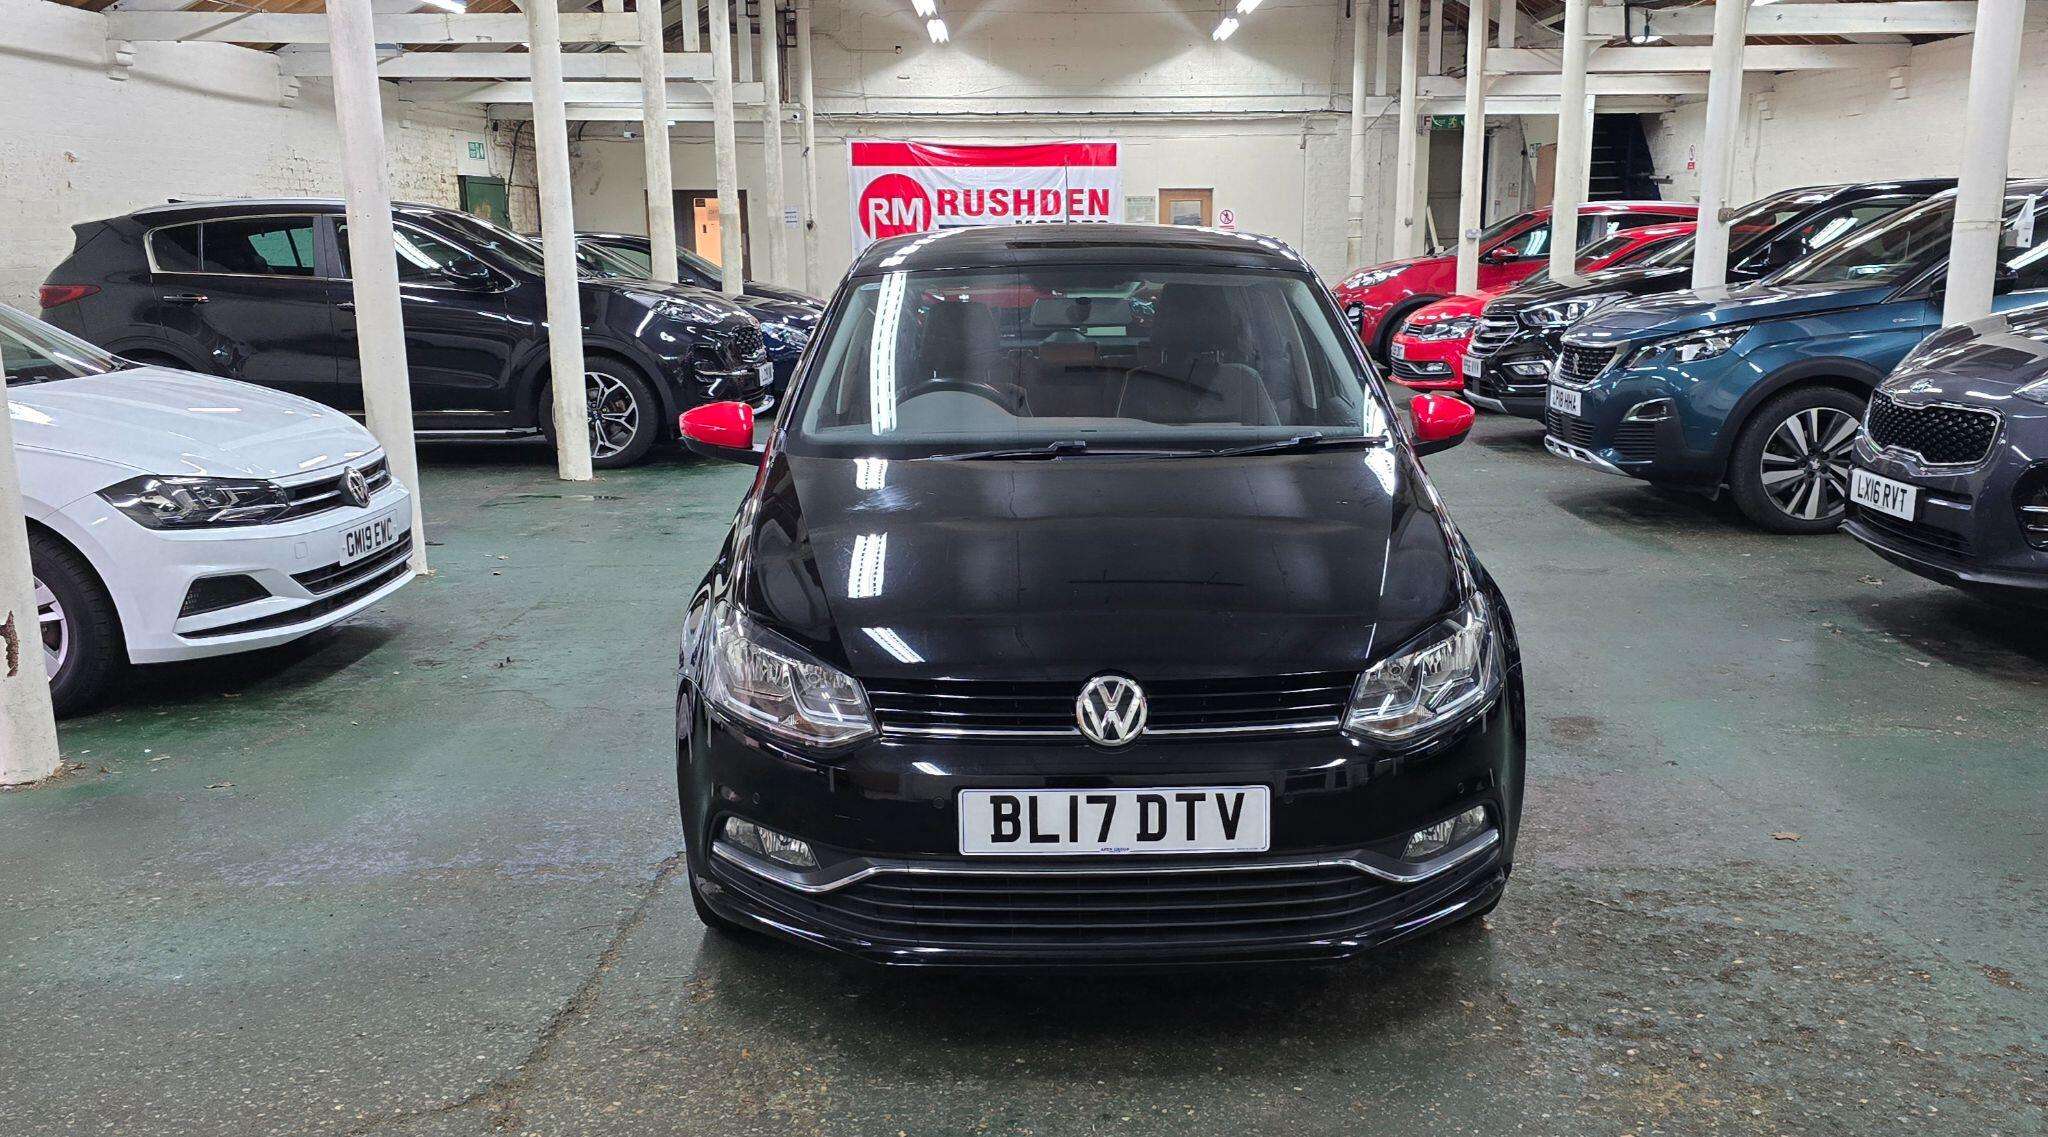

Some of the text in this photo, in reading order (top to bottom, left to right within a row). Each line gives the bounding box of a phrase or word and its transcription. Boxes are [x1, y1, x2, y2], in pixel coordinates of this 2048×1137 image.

[868, 197, 924, 239] RM
[936, 188, 1110, 217] RUSHDEN
[1857, 474, 1908, 513] LX16 RVT
[346, 525, 372, 557] GM19
[990, 792, 1245, 844] BL17 DTV
